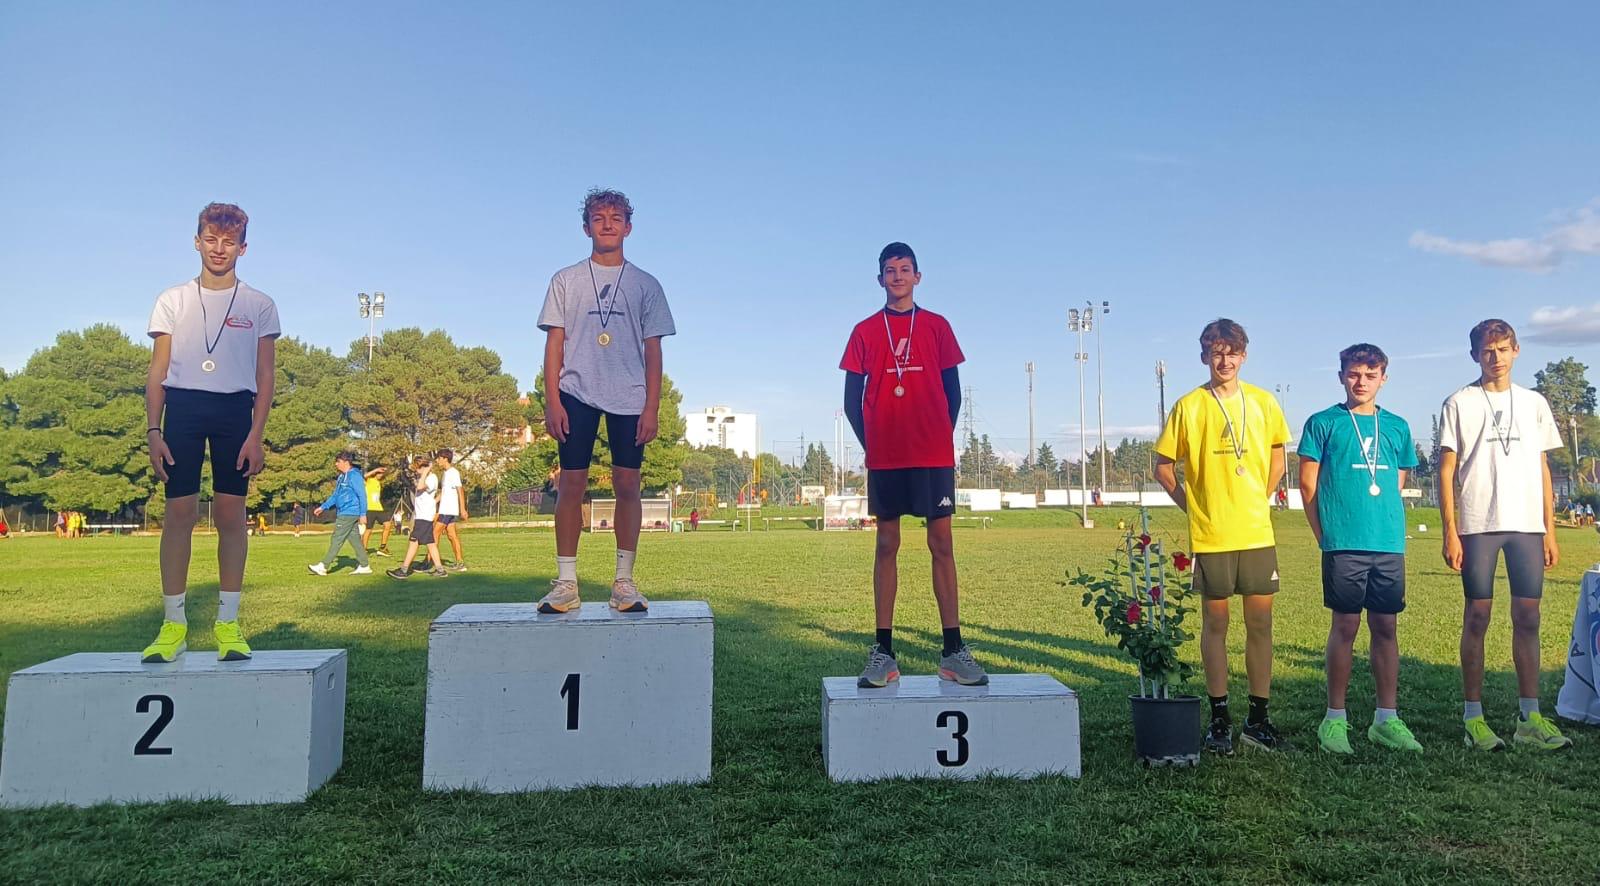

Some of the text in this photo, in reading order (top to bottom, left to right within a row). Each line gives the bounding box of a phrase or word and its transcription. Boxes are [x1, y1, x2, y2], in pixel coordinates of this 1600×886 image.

[134, 694, 175, 755] 2
[560, 673, 580, 730] 1
[936, 711, 969, 767] 3
